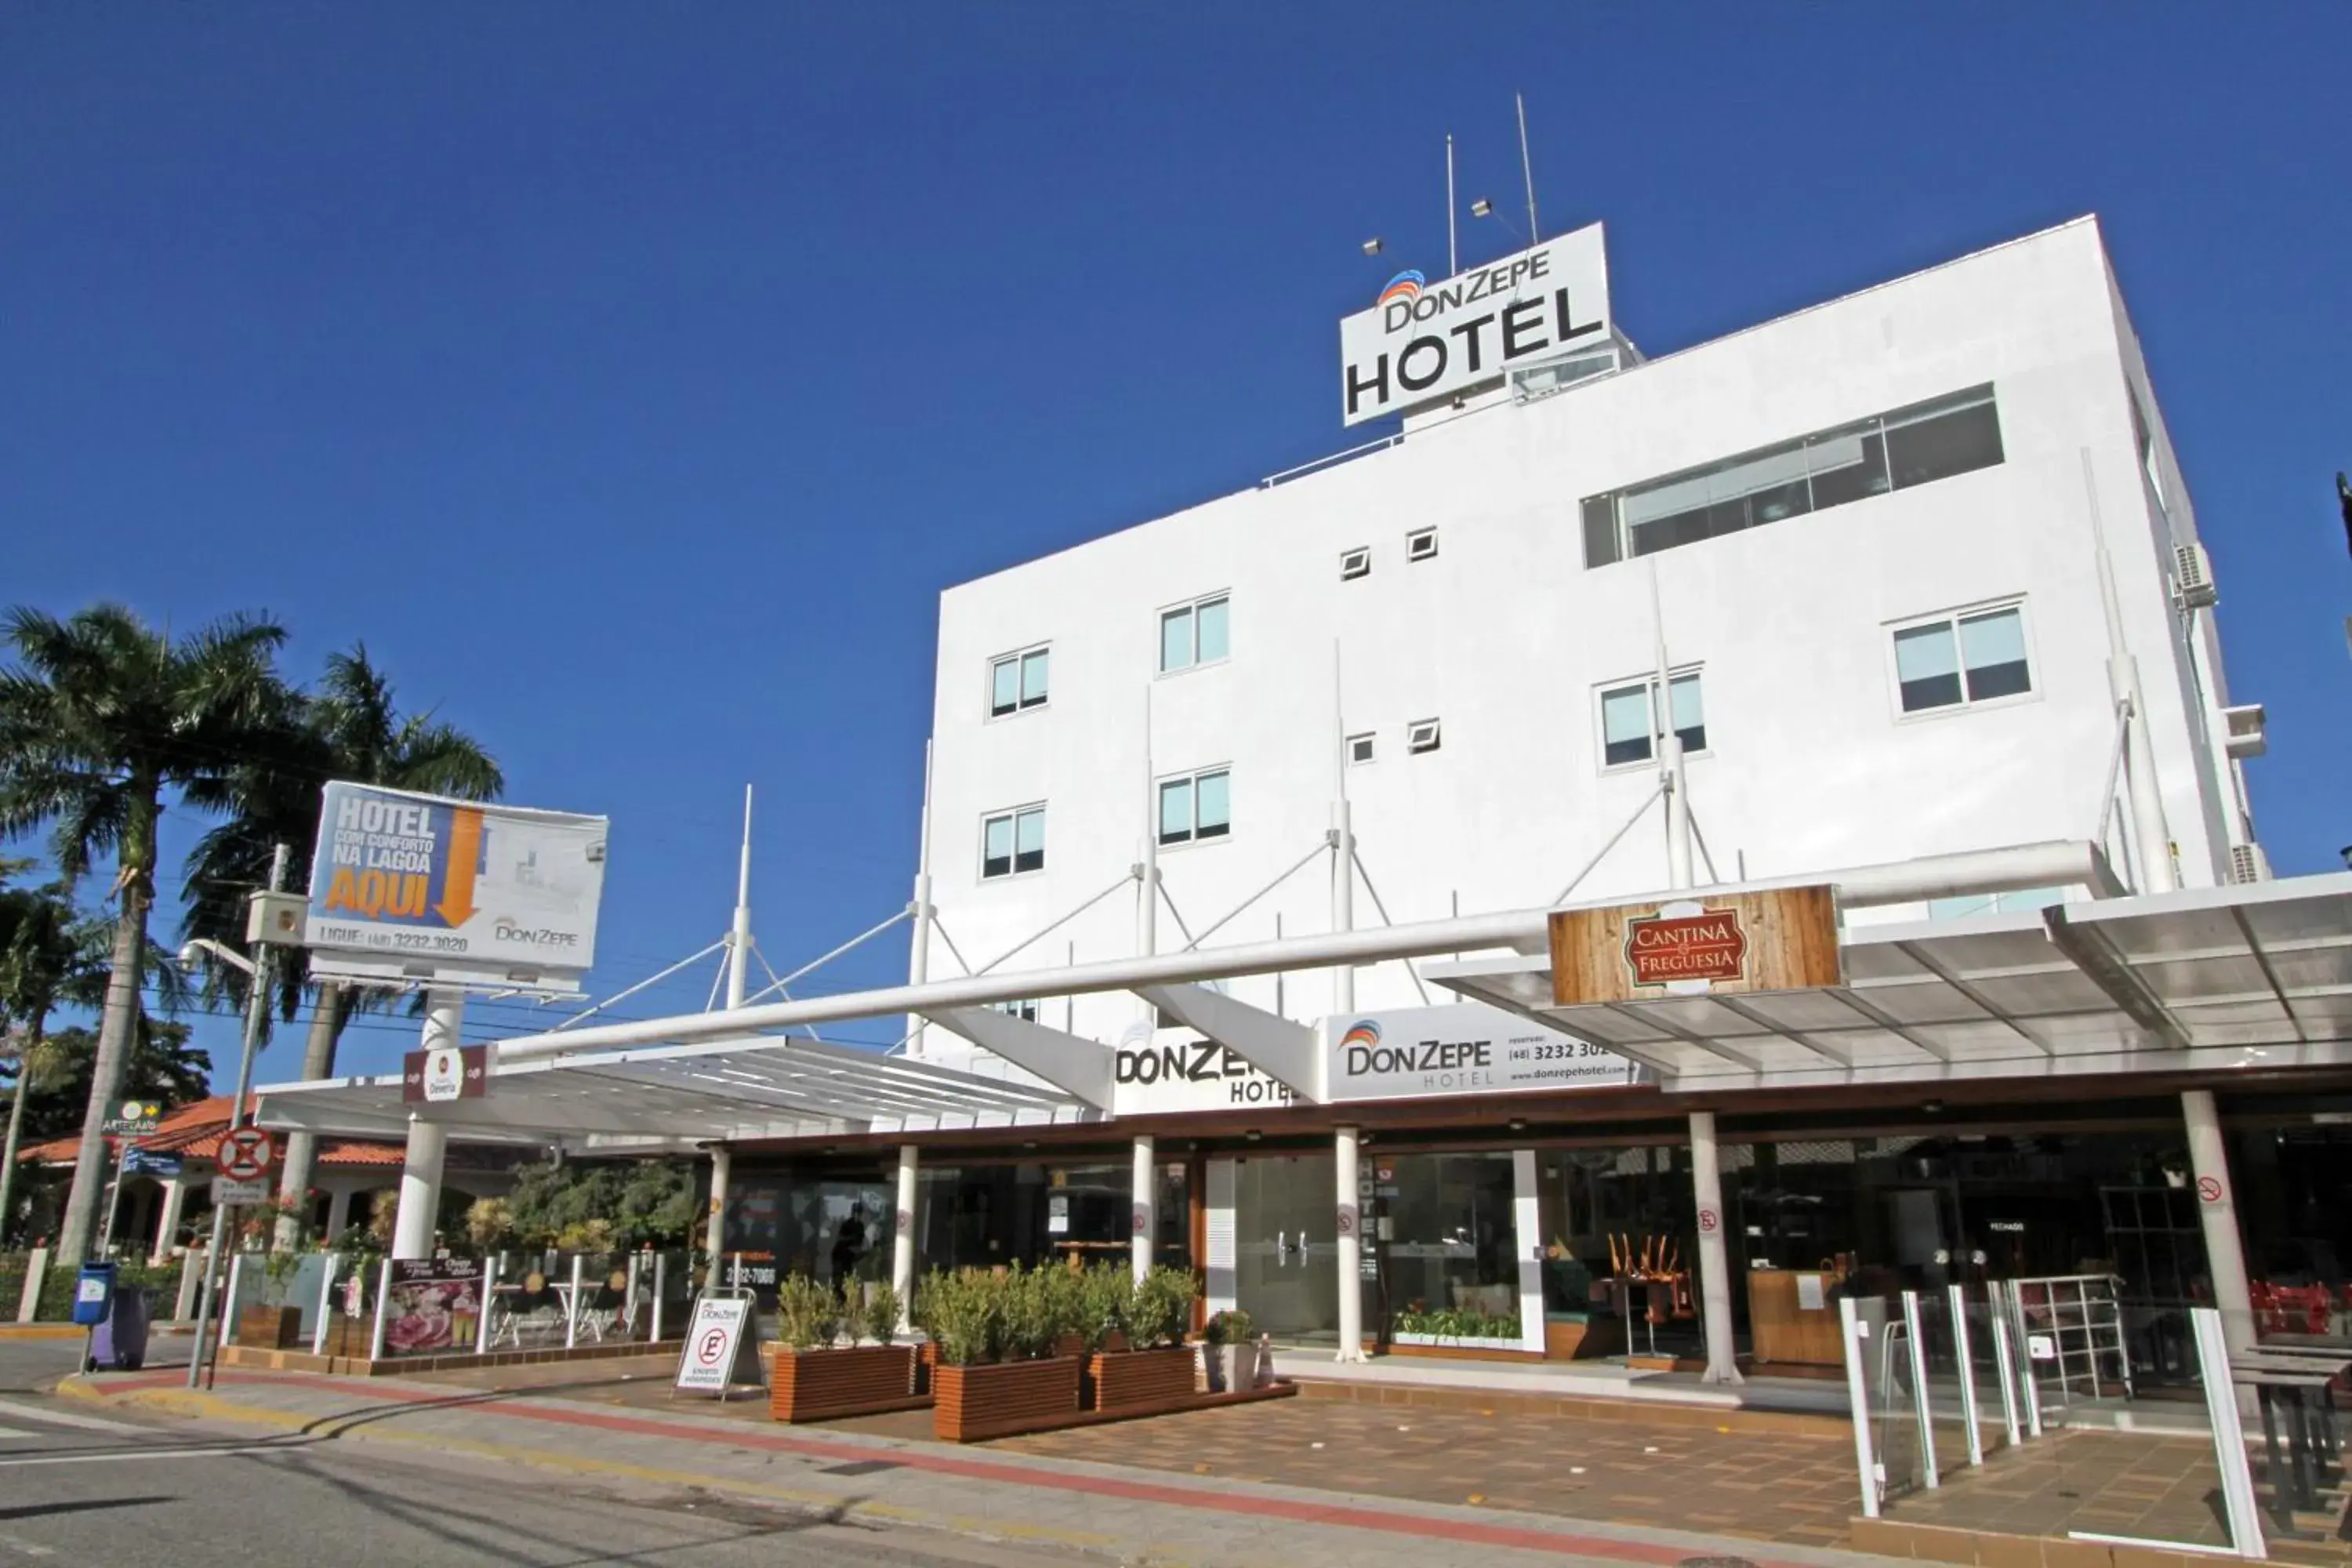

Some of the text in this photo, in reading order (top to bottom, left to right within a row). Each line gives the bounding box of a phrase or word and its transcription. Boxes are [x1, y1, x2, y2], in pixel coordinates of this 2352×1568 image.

[1346, 287, 1603, 415] HOTEL
[336, 797, 436, 840] HOTEL
[334, 829, 434, 853] COM CONFORTO
[332, 844, 431, 873] NA LAGOA
[325, 867, 429, 920] AQUI
[1636, 921, 1730, 947] CANTINA
[1639, 949, 1734, 973] FREGUESIA
[1116, 1040, 1255, 1086] DONZE
[1509, 1042, 1610, 1061] (48) 3232 30
[1424, 1070, 1494, 1089] HOTEL
